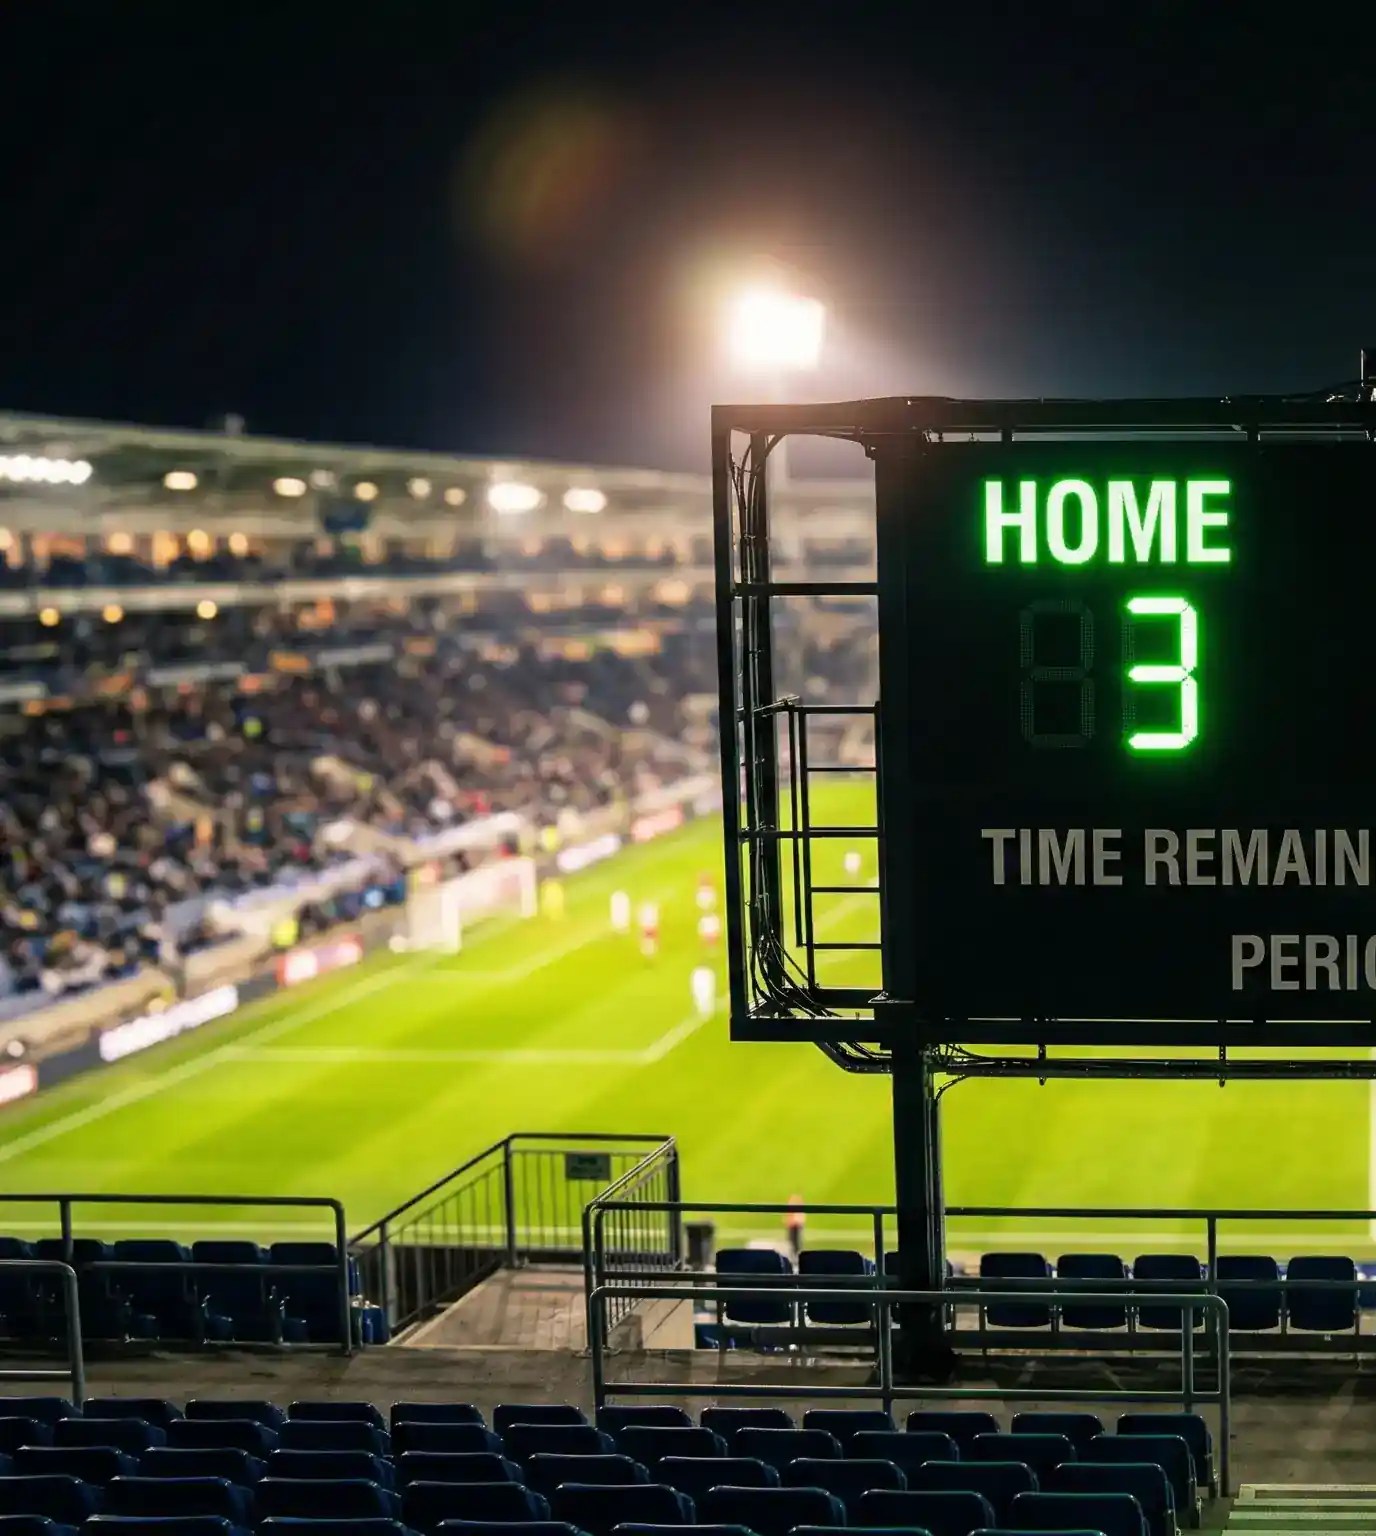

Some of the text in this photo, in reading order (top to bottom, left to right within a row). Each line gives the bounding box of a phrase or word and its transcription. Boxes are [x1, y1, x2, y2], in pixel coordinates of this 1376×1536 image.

[984, 478, 1231, 567] HOME
[1124, 593, 1201, 753] 3
[981, 828, 1123, 886] TIME
